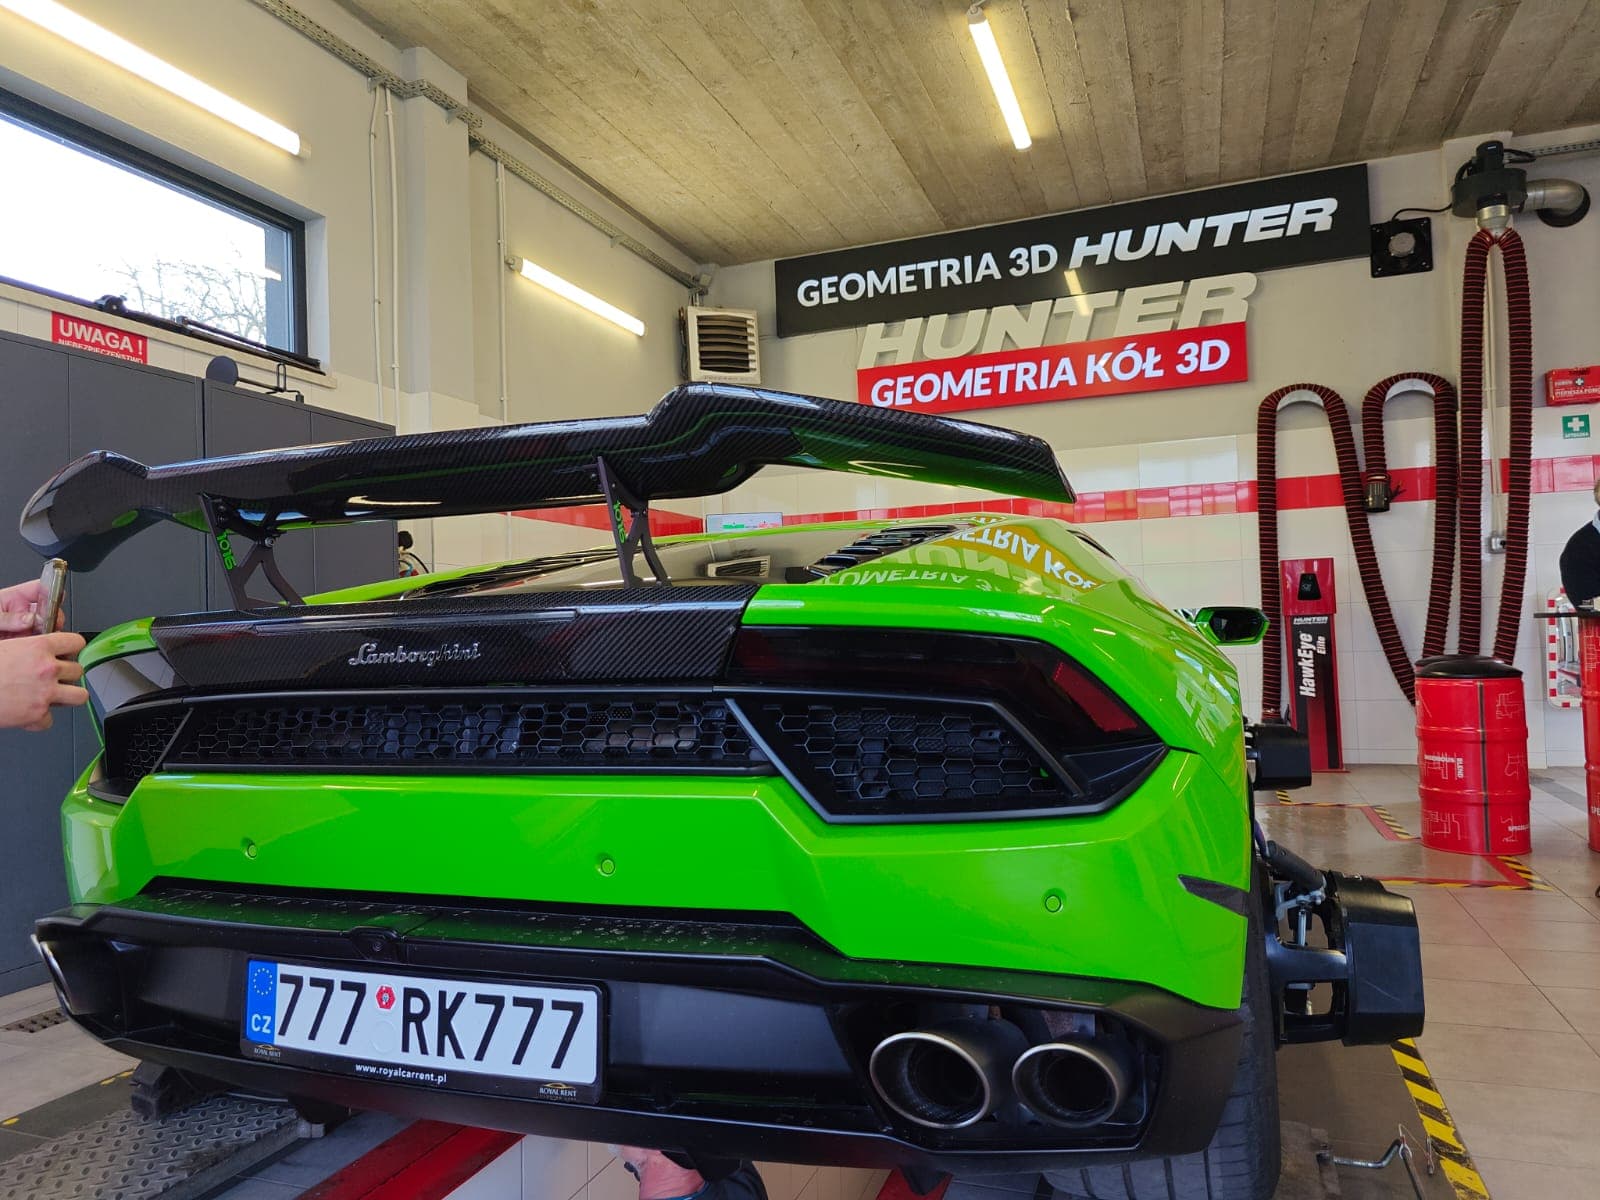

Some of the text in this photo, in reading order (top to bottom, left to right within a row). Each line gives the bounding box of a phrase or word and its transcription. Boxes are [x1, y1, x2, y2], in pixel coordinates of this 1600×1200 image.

[797, 197, 1338, 307] GEOMETRIA 3D HUNTER
[59, 318, 134, 353] UWAGA
[857, 272, 1258, 369] HUNTER
[871, 338, 1231, 408] GEOMETRIA KÓŁ 3D
[348, 642, 481, 667] Lamborghini
[1297, 633, 1317, 698] HawkEye
[1316, 635, 1327, 655] Elite
[251, 1013, 271, 1035] CZ
[278, 972, 584, 1070] 777 RK777
[355, 1063, 447, 1085] www.royalcarrent.pl
